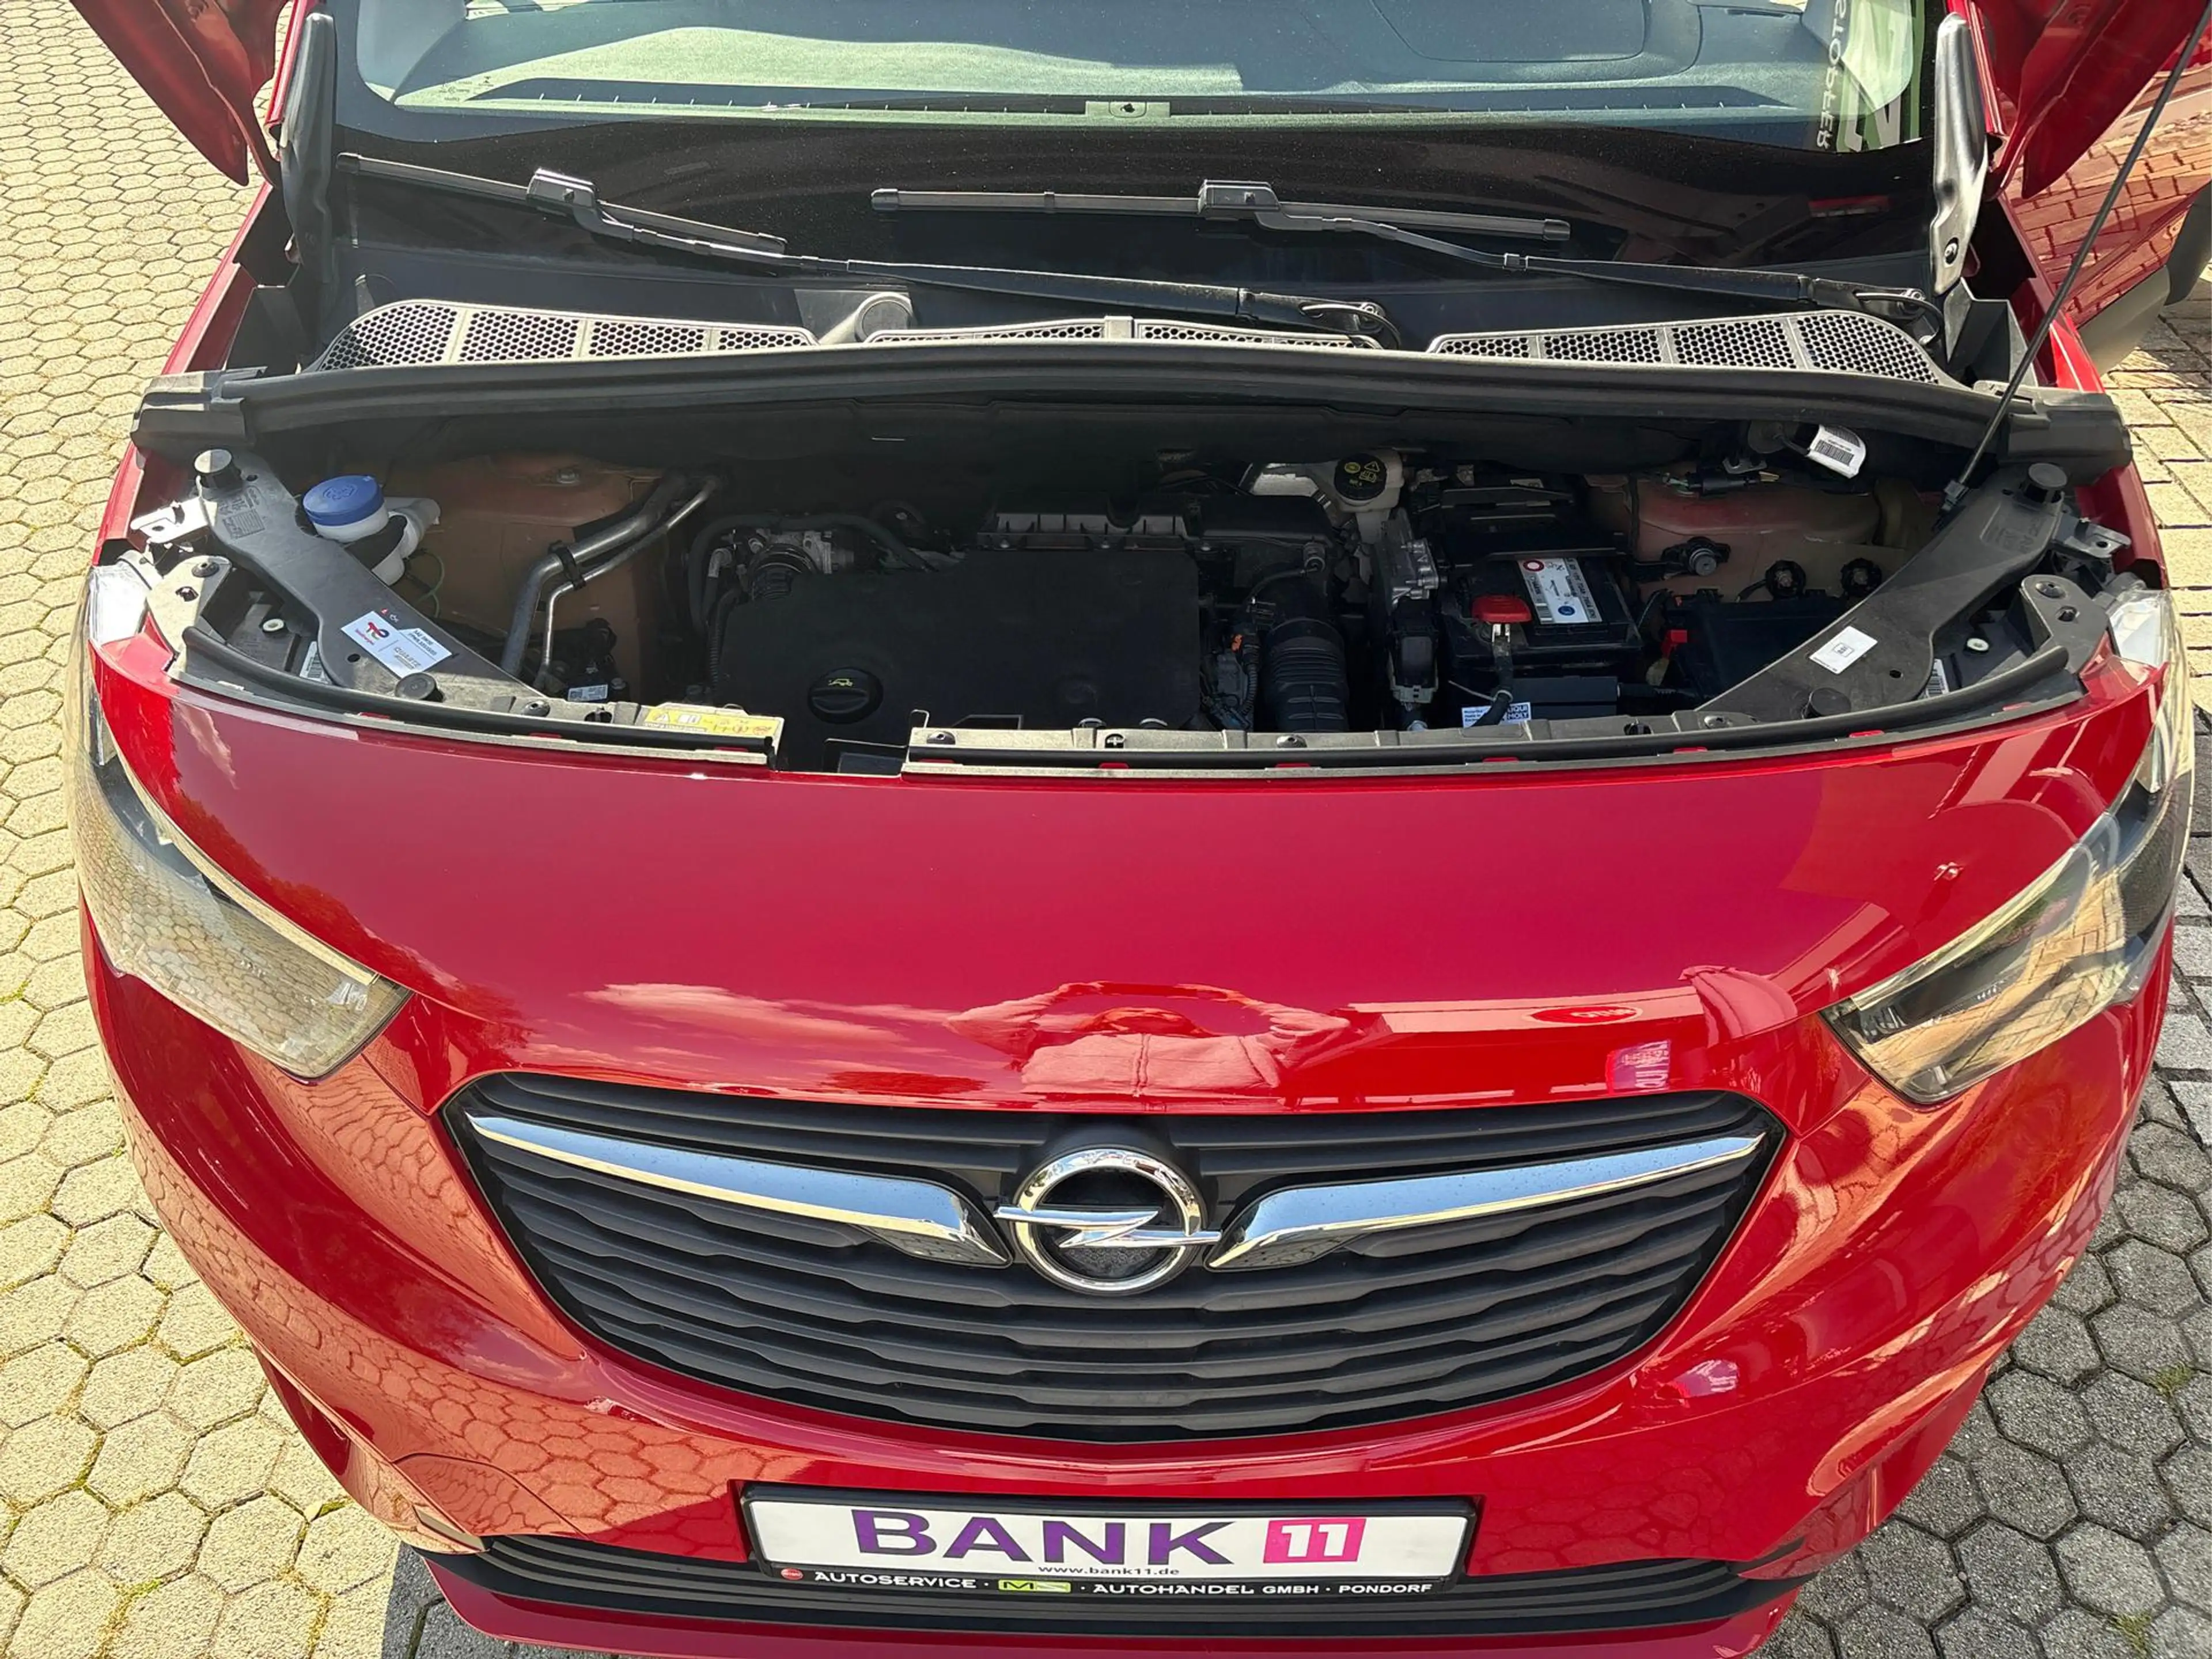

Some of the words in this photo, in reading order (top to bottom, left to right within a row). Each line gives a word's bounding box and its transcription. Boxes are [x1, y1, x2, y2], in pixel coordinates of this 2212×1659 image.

[851, 1510, 1236, 1565] BANK
[1281, 1524, 1349, 1558] 11
[814, 1571, 977, 1588] AUTOSERVICE
[1093, 1584, 1255, 1594] AUTOHANDEL
[1262, 1585, 1319, 1594] GMBH
[1338, 1584, 1433, 1593] PONDORF
[1038, 1566, 1180, 1577] www.bank11.de
